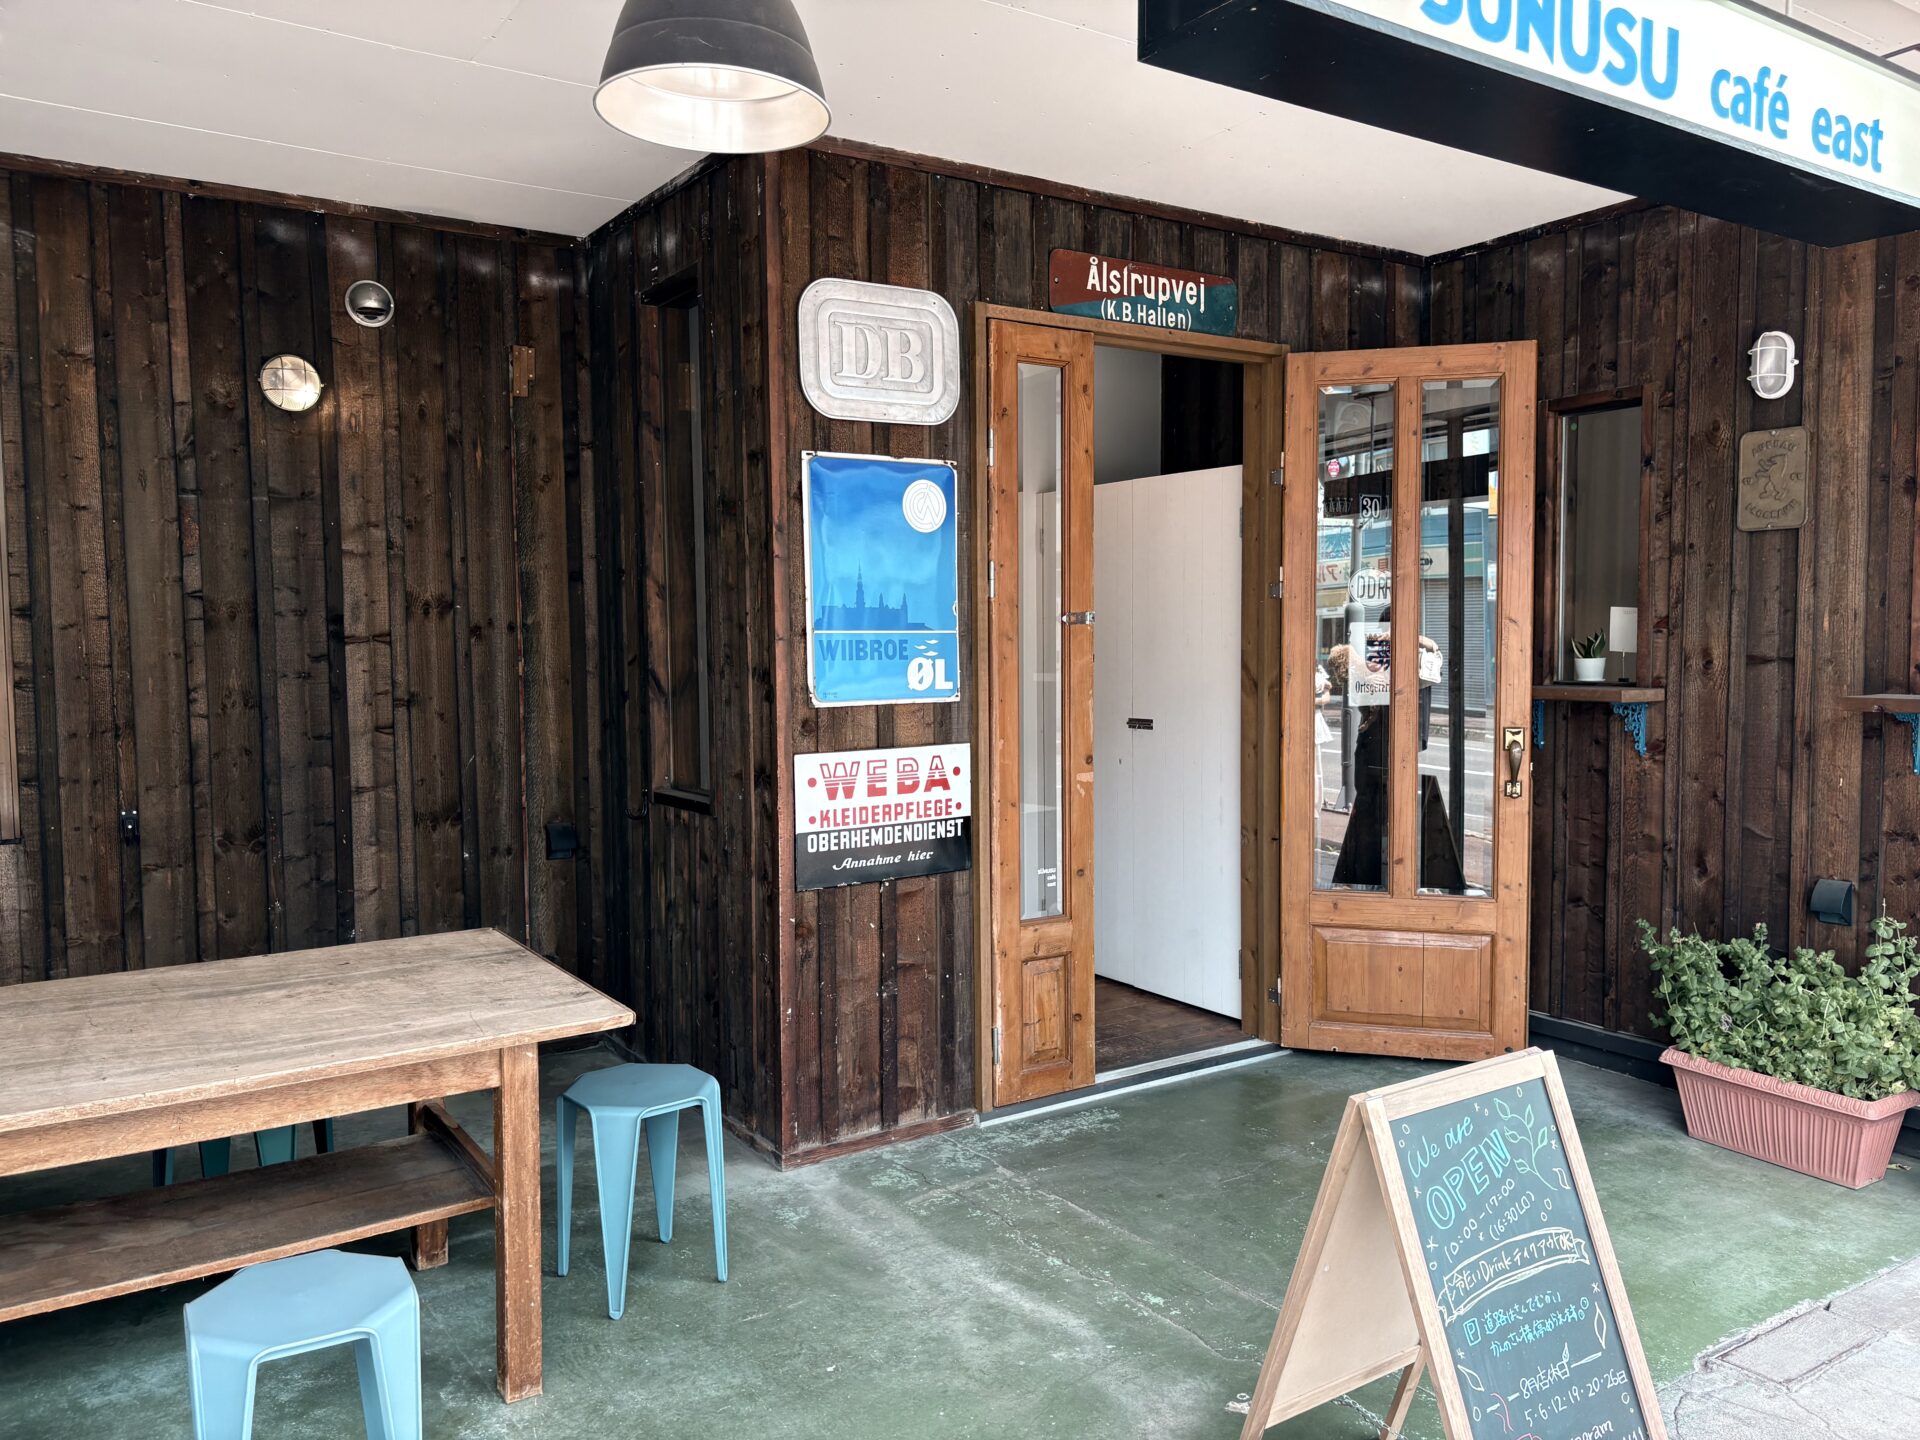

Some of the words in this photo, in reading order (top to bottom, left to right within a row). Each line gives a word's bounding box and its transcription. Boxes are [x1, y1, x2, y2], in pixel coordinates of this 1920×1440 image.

[1710, 65, 1790, 140] café
[1810, 104, 1884, 174] east
[834, 320, 925, 384] DB
[1362, 497, 1381, 518] 30
[818, 639, 909, 662] WIIBROE
[907, 656, 954, 691] ØL
[819, 755, 951, 801] WEBA
[819, 798, 953, 829] KLEIDERPFLEGE
[807, 818, 964, 853] OBERHEMDENDIENST
[832, 854, 902, 871] Annahme
[907, 850, 934, 862] hier
[1407, 1134, 1440, 1178] We
[1445, 1116, 1474, 1149] are
[1426, 1129, 1511, 1230] OPEN
